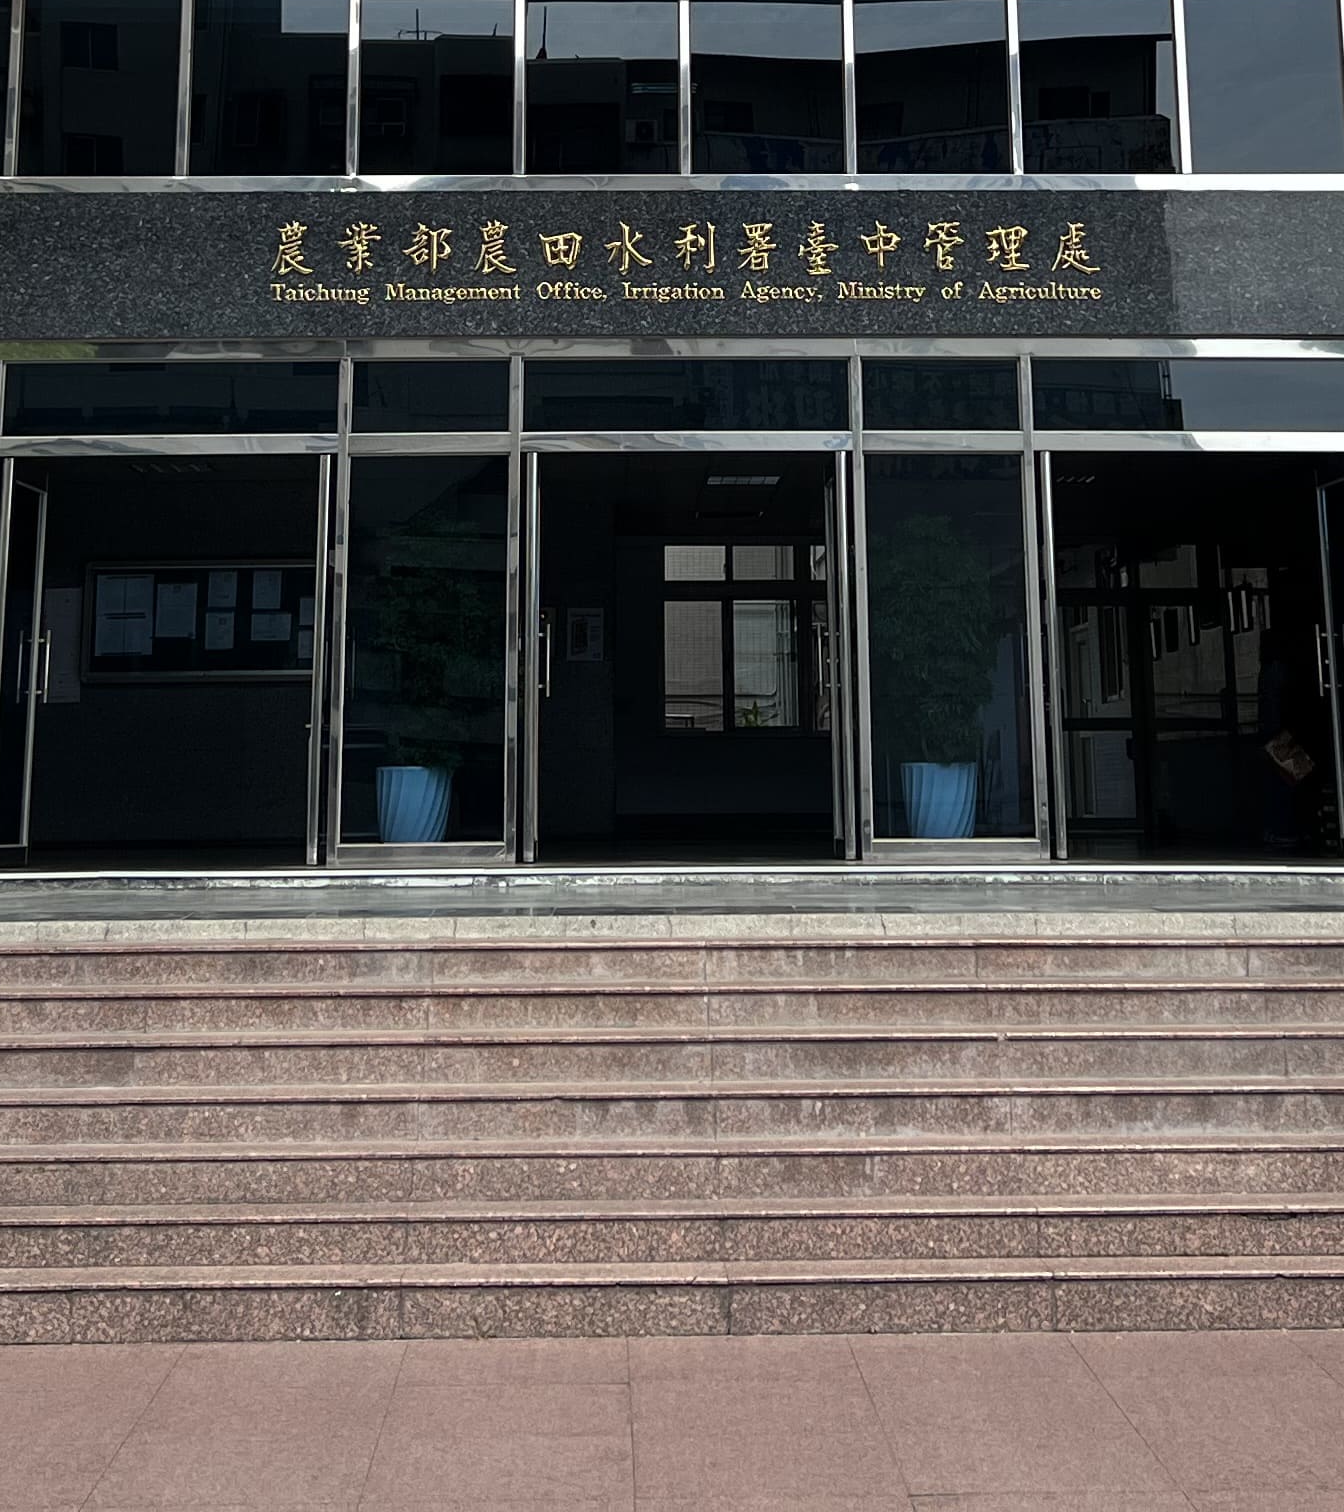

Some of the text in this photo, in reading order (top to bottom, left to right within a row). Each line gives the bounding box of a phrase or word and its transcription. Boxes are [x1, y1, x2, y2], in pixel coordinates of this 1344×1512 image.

[271, 219, 1101, 275] 農業部農田水利署臺中管理處
[271, 281, 1102, 304] Taichung Management Office, Irrigation Agency, Ministry of Agriculture
